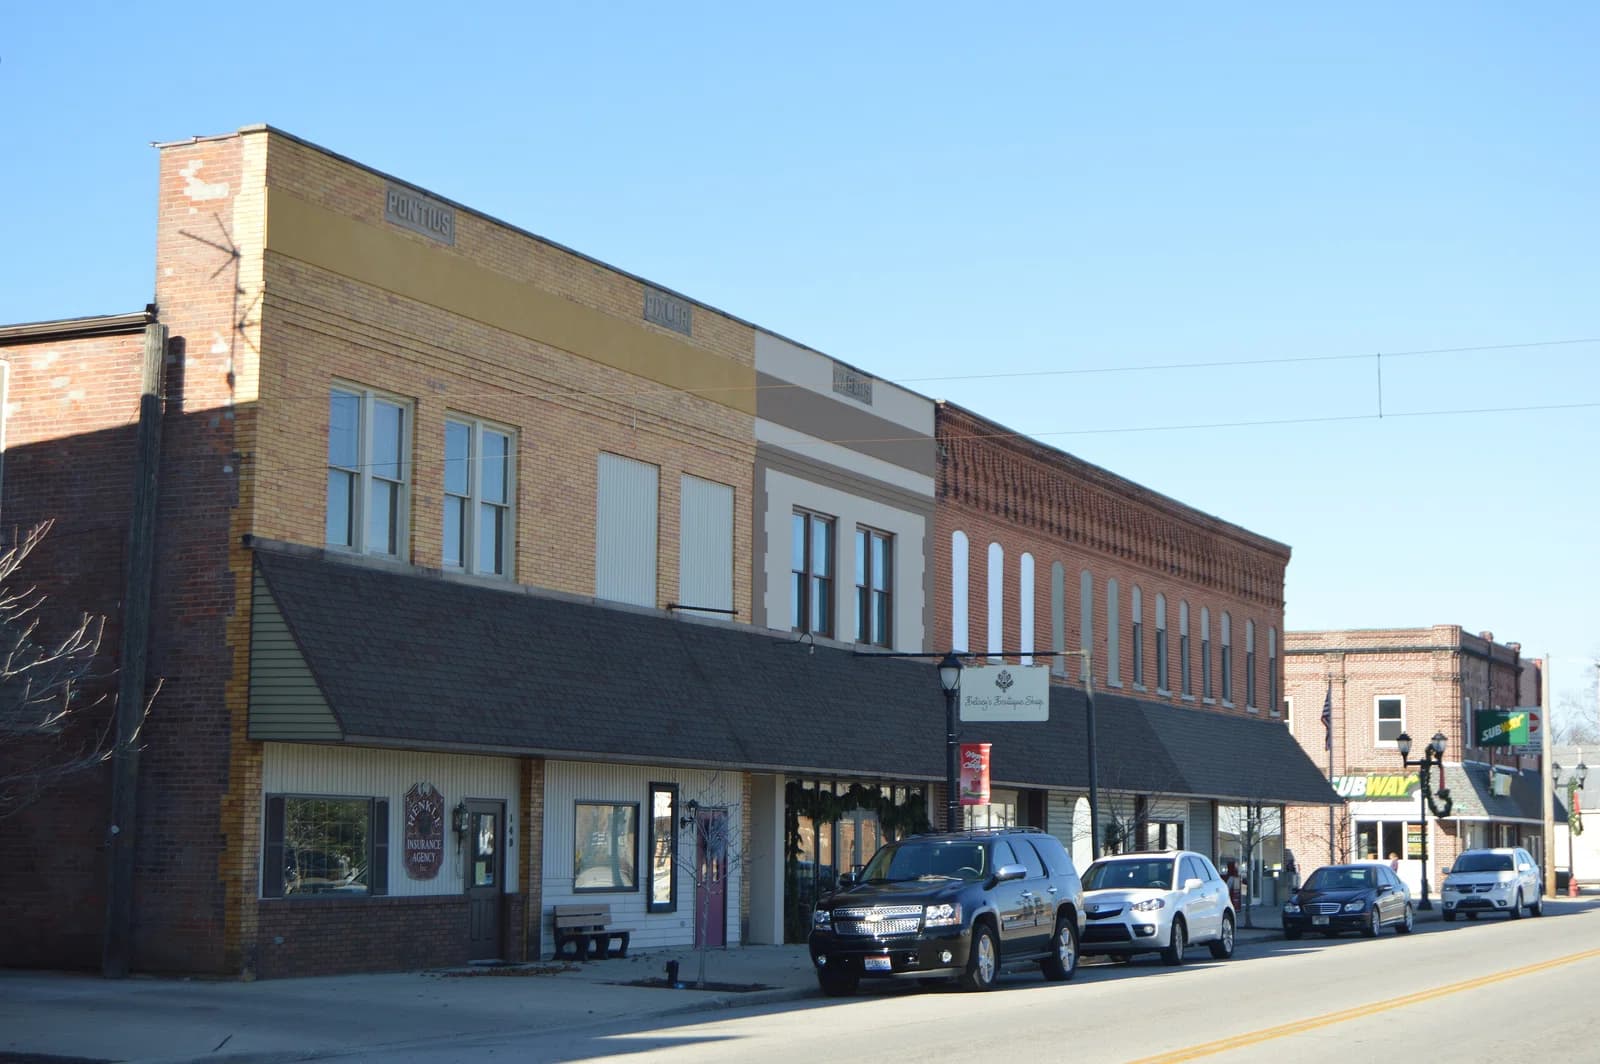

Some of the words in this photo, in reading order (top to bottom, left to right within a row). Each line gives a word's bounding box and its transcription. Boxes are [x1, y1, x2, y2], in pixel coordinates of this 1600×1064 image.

[388, 191, 450, 236] PONTIUS
[1025, 696, 1046, 711] Shop
[1482, 713, 1525, 741] SUBWAY
[407, 839, 441, 849] INSURANCE
[412, 852, 436, 863] AGENCY
